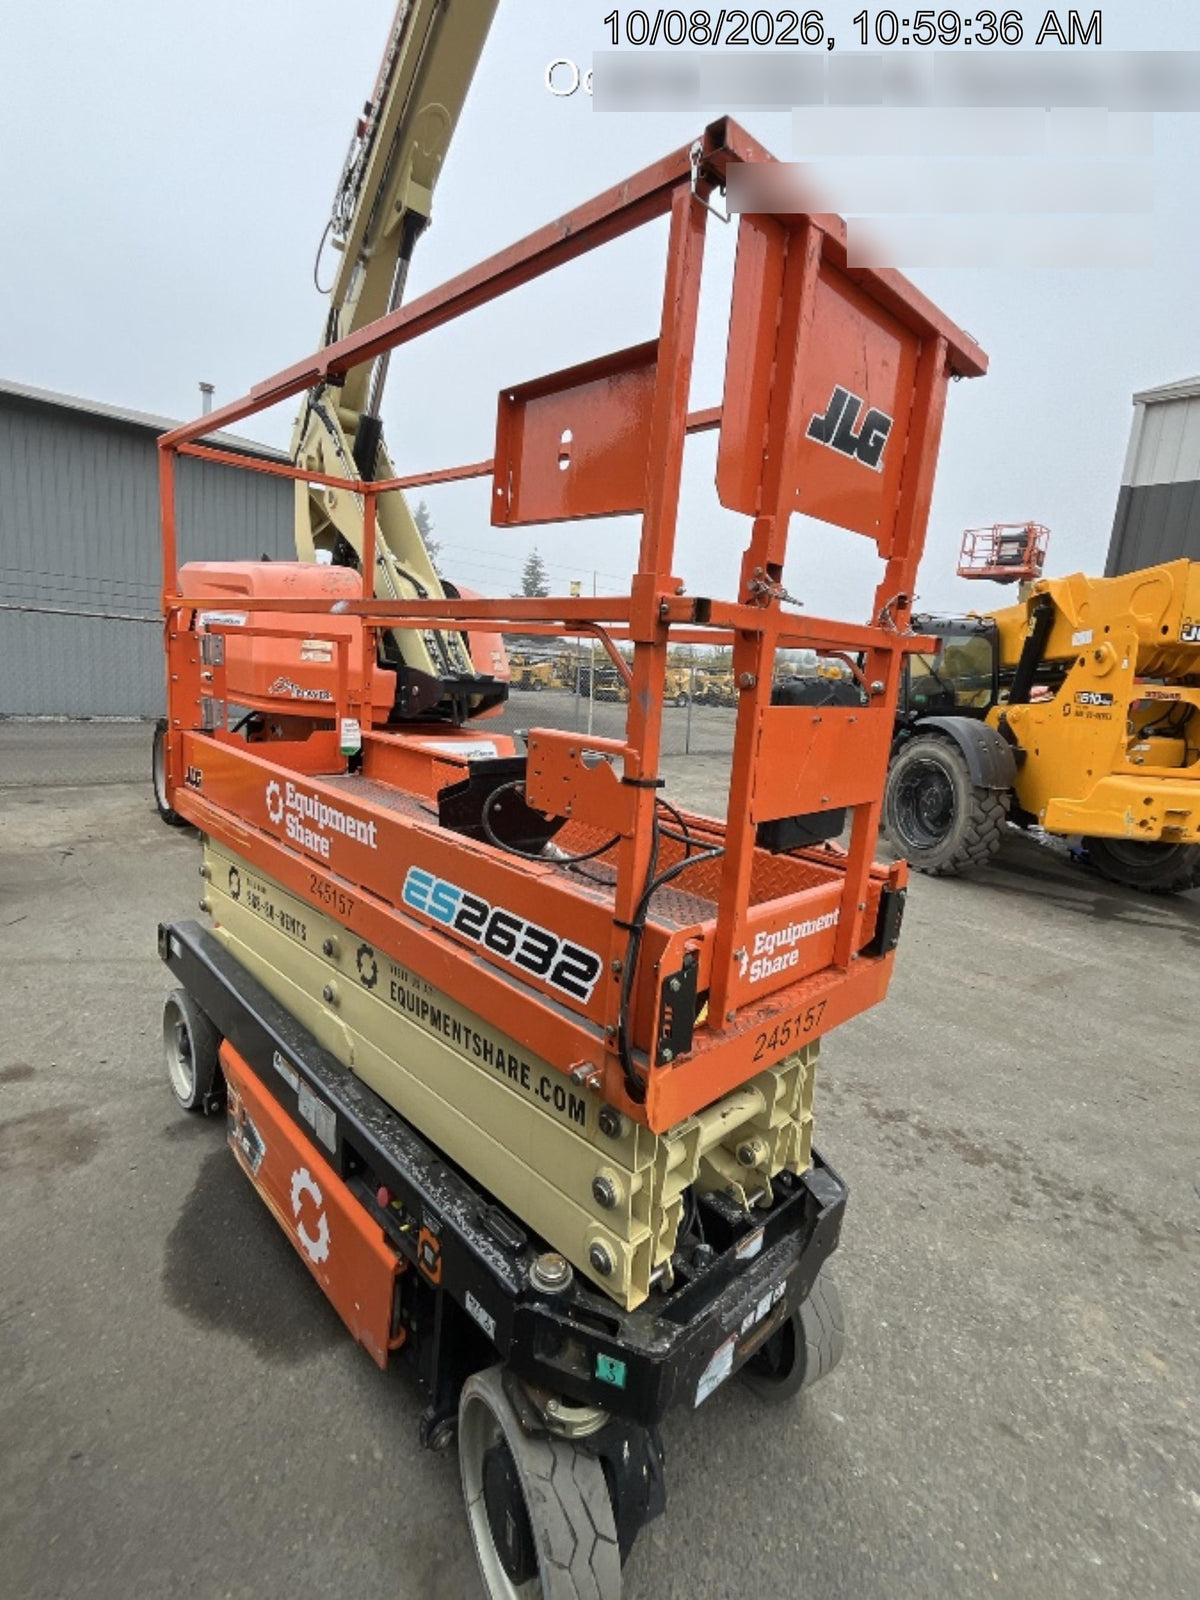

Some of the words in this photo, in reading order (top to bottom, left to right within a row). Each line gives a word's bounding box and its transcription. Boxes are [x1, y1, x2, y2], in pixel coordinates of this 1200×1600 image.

[805, 384, 894, 473] JLG
[285, 781, 378, 850] Equipment
[285, 812, 331, 859] Share
[310, 873, 355, 918] 245157
[403, 865, 603, 1004] ES2632
[753, 908, 841, 956] Equipment
[749, 949, 800, 984] Share
[390, 980, 586, 1127] EQUIPMENTSHARE.COM
[753, 1000, 828, 1063] 245157
